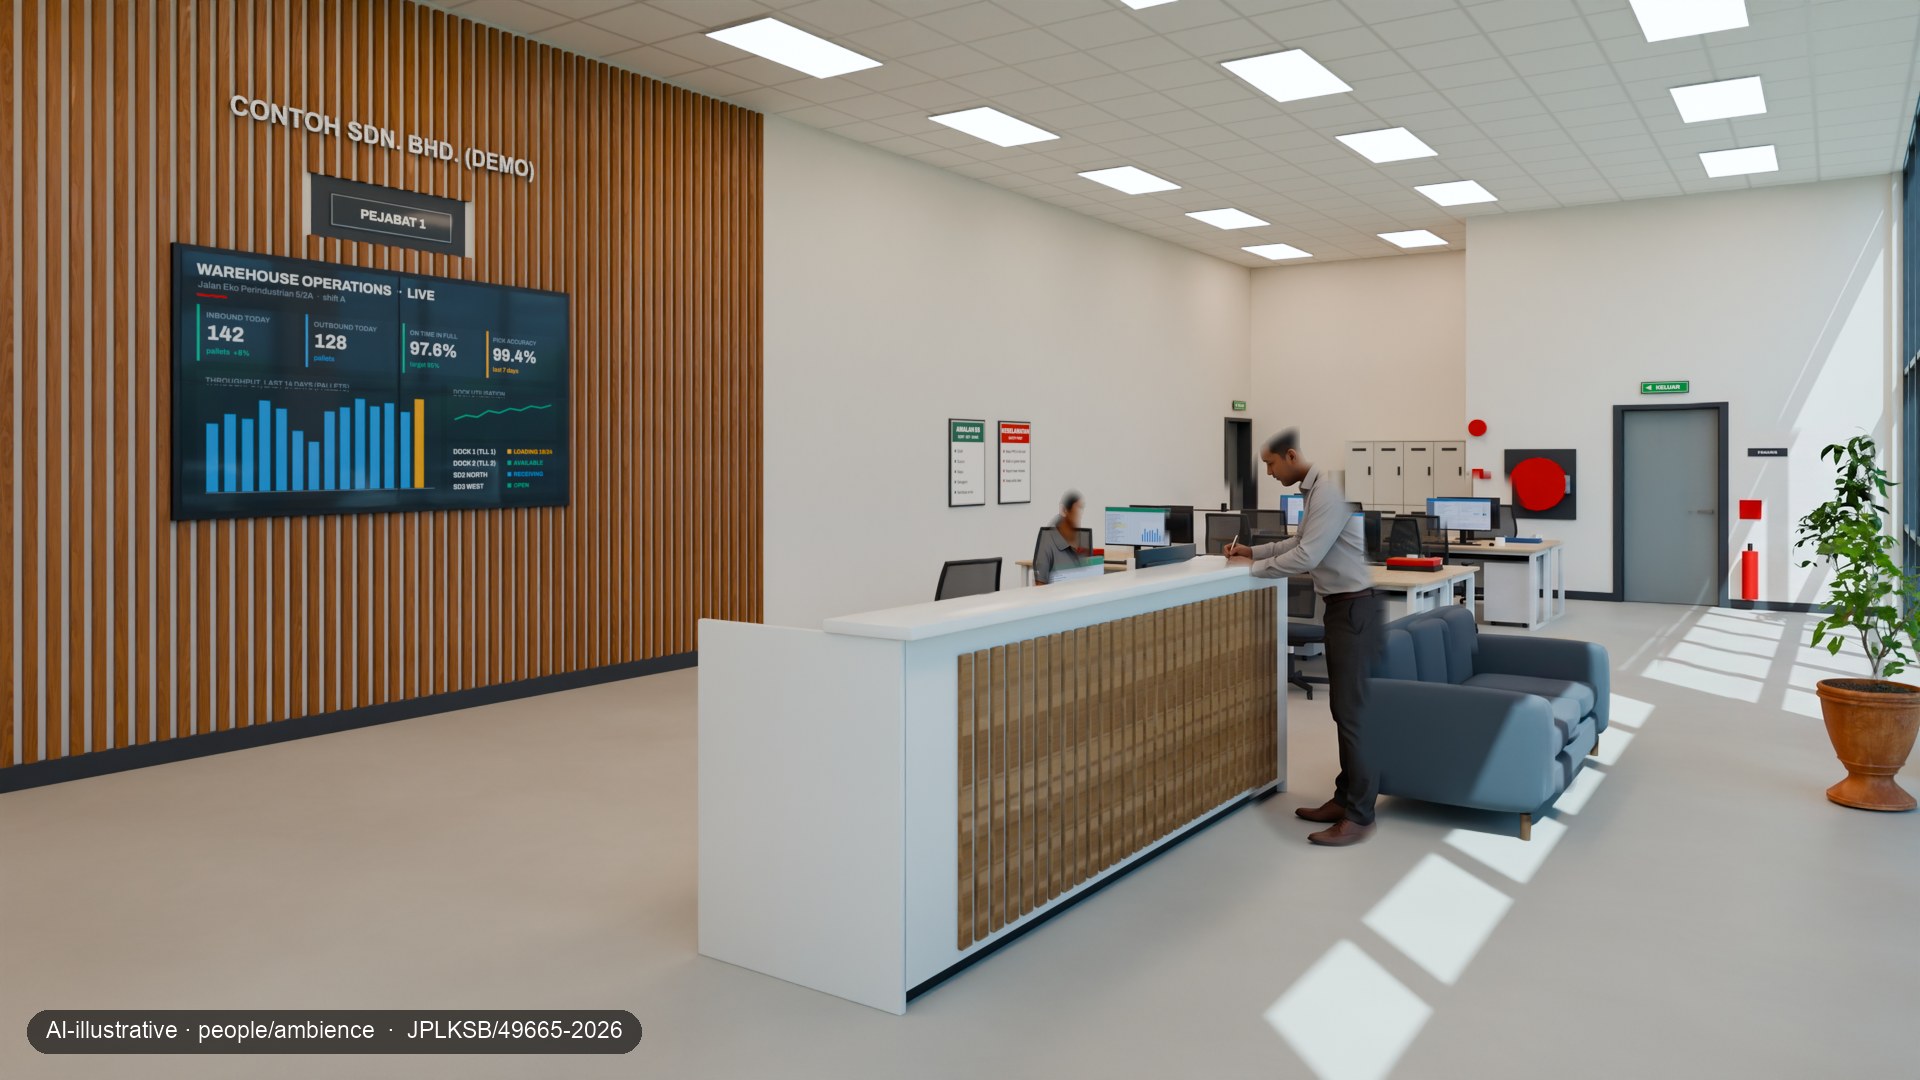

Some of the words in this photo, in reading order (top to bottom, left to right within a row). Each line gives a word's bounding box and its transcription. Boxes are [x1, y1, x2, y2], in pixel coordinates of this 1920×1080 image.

[230, 95, 340, 137] CONTOH
[347, 121, 401, 150] SDN.
[408, 134, 459, 163] BHD.
[465, 147, 535, 183] (DEMO)
[360, 209, 416, 228] PEJABAT
[419, 218, 426, 229] 1
[196, 262, 299, 288] WAREHOUSE
[302, 275, 392, 296] OPERATIONS
[407, 287, 435, 302] LIVE
[198, 281, 221, 290] Jalan
[223, 283, 240, 292] Eko
[241, 285, 294, 298] Perindustrian
[295, 290, 314, 300] 5/2A
[323, 294, 338, 302] shift
[206, 312, 243, 321] INBOUND
[244, 315, 270, 323] TODAY
[314, 321, 353, 331] OUTBOUND
[207, 325, 244, 342] 142
[314, 333, 347, 350] 128
[206, 348, 230, 356] pallets
[410, 341, 457, 359] 97.6%
[493, 347, 536, 364] 99.4%
